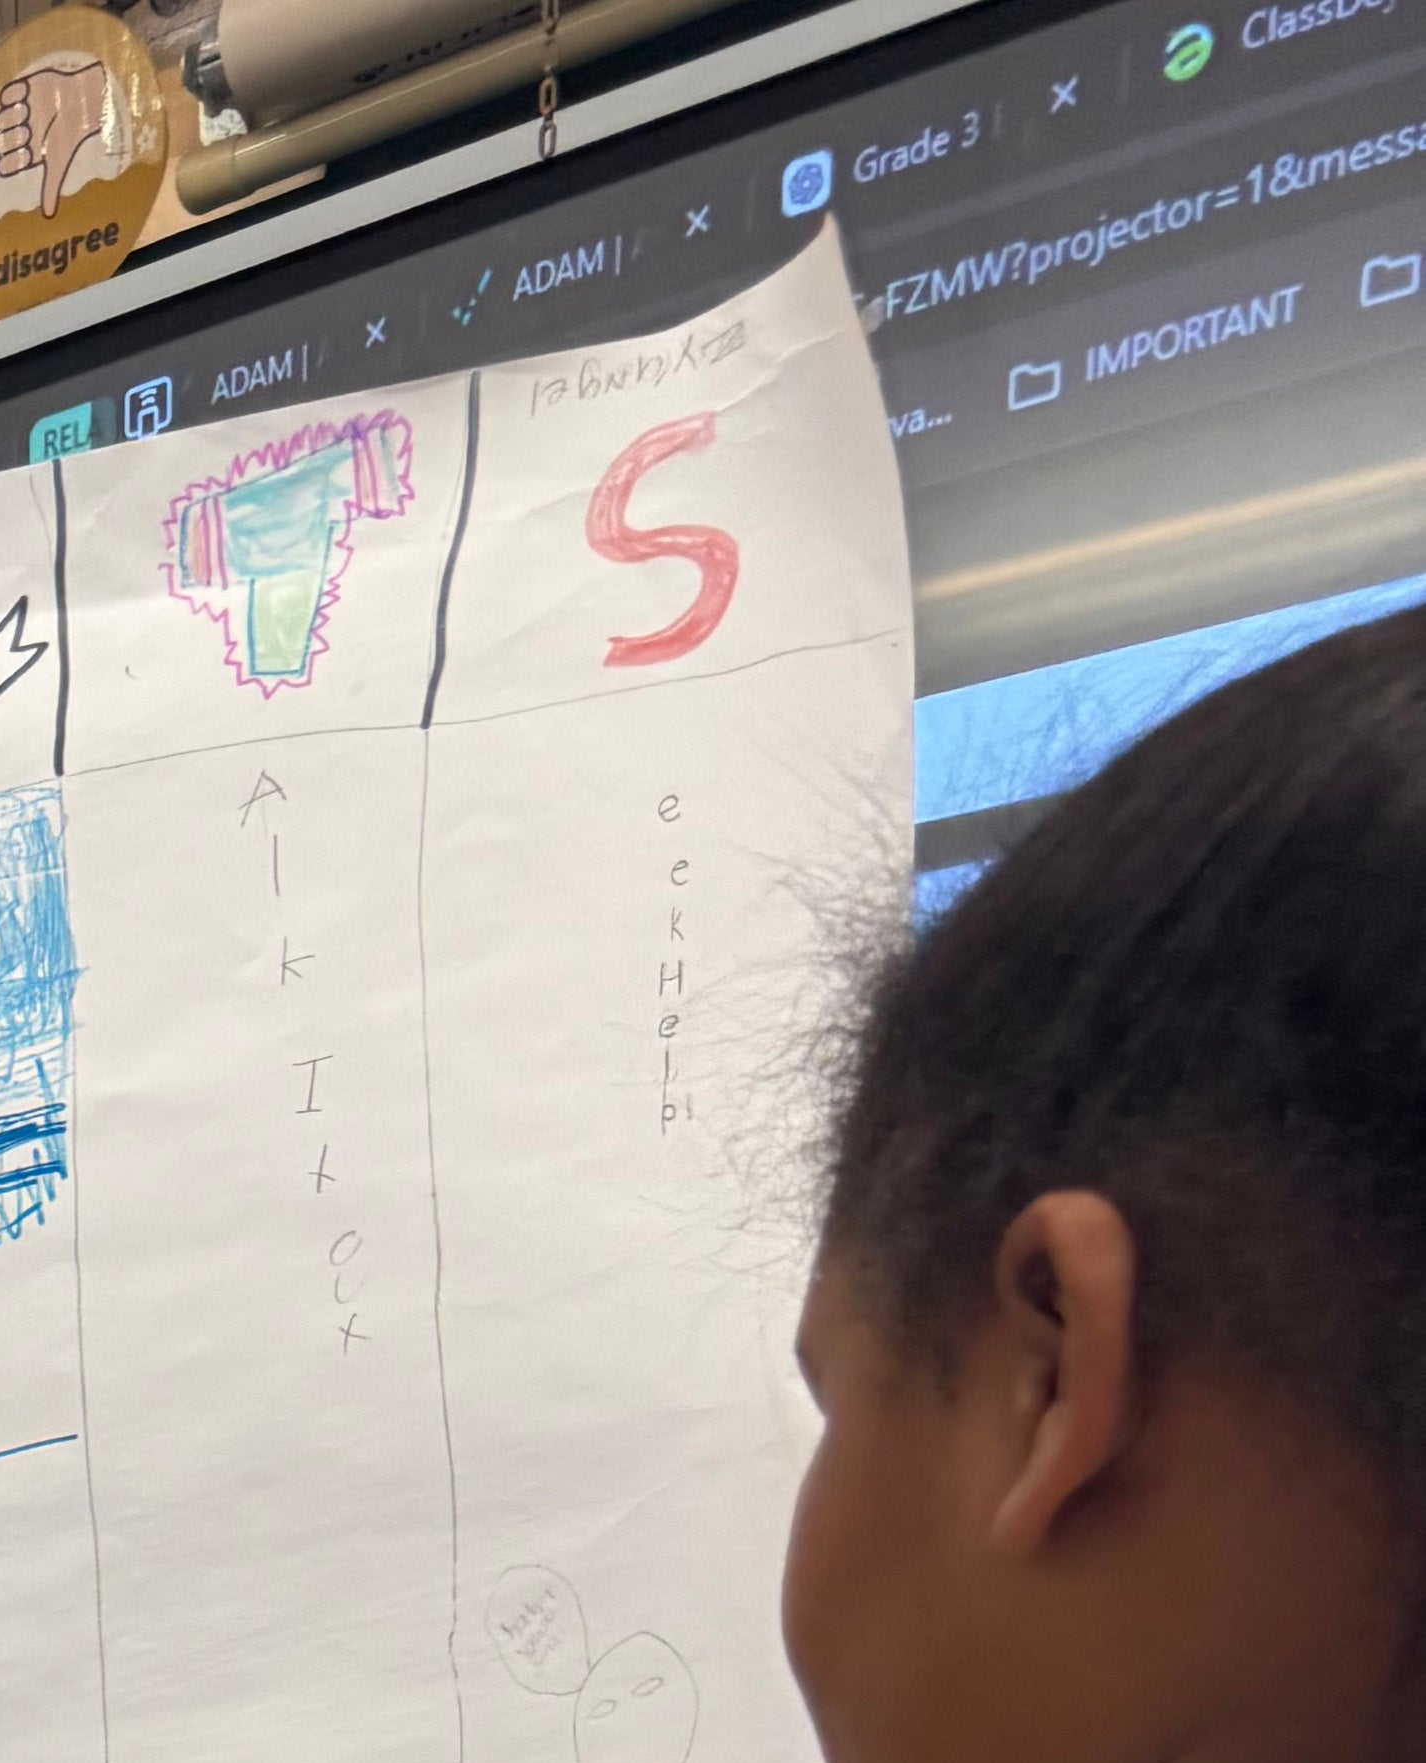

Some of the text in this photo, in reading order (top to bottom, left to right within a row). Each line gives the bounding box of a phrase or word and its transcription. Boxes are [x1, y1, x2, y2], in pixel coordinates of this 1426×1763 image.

[1242, 0, 1399, 49] ClassD
[853, 112, 981, 184] Grade 3
[513, 240, 604, 300] ADAM
[1085, 284, 1304, 382] IMPORTANT
[211, 352, 292, 405] ADAM
[586, 411, 738, 667] S
